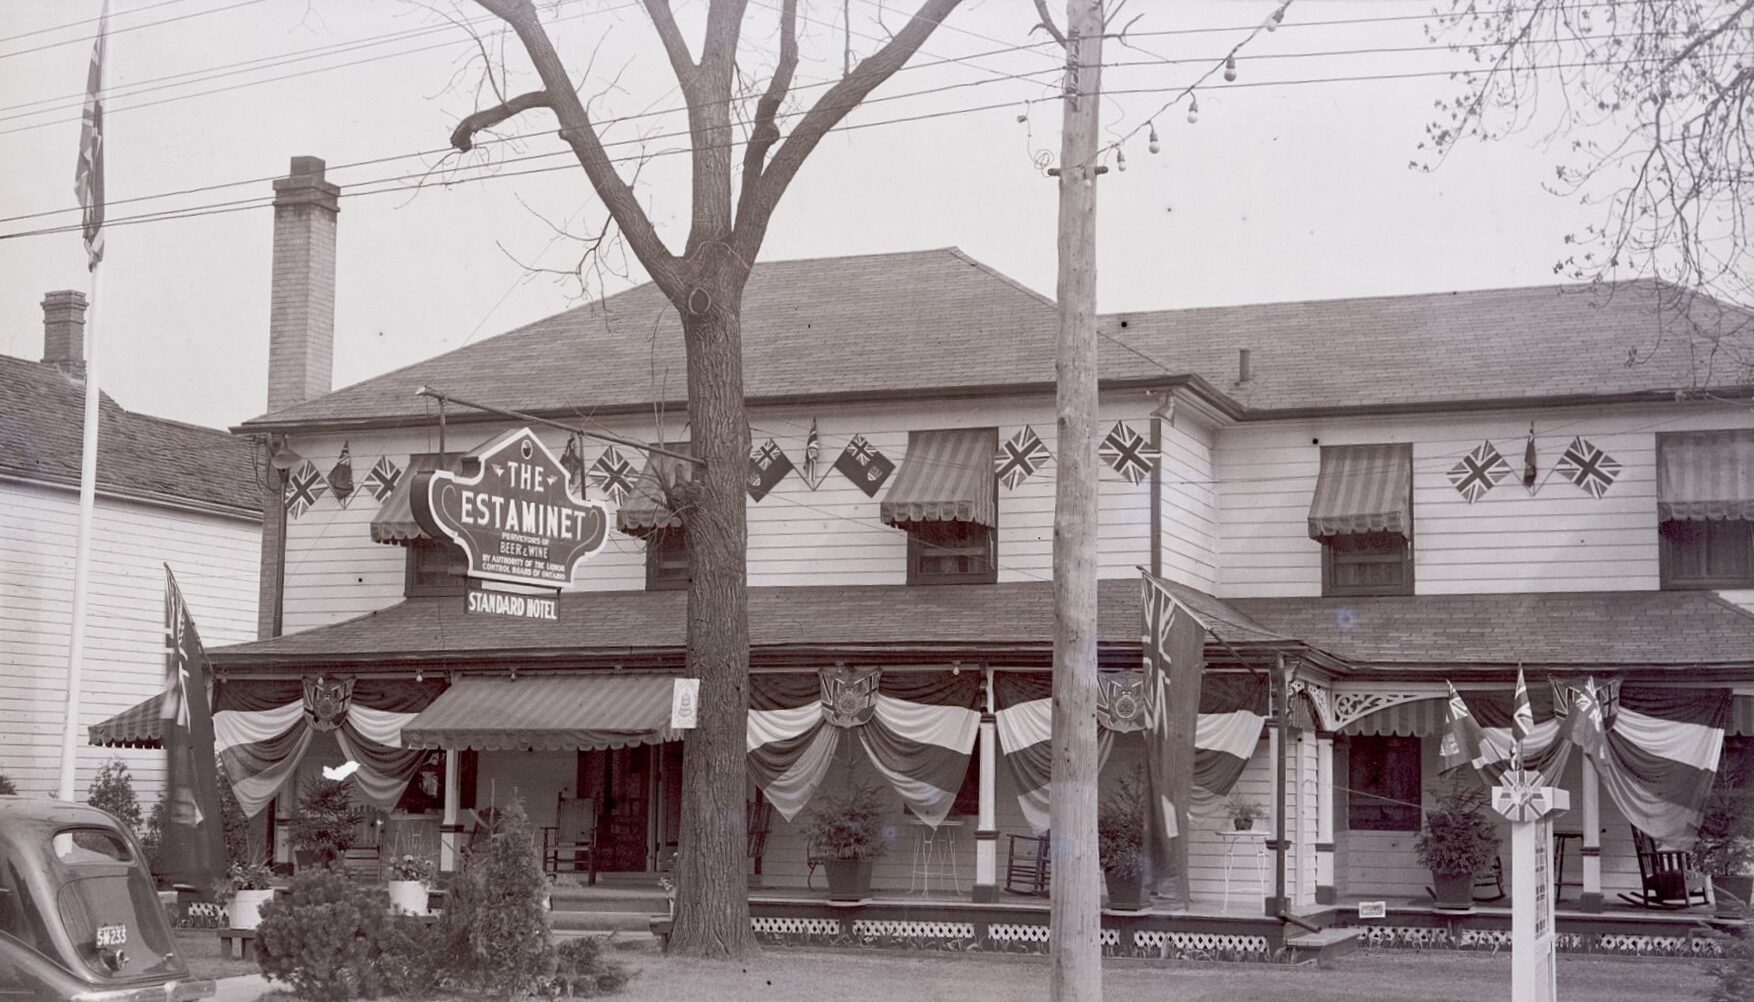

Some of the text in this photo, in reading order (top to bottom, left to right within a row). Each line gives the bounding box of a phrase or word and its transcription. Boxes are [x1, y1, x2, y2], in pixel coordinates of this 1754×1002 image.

[507, 461, 544, 492] THE
[461, 490, 586, 540] ESTAMINET
[500, 541, 522, 556] BEER
[528, 545, 549, 560] WINE
[541, 537, 550, 545] OF
[482, 553, 566, 572] BY AUTHORITY OF THE LIQUOR
[482, 562, 566, 581] CONTROL BOARD OF ONTARIO
[468, 591, 557, 620] STANDARD HOTEL
